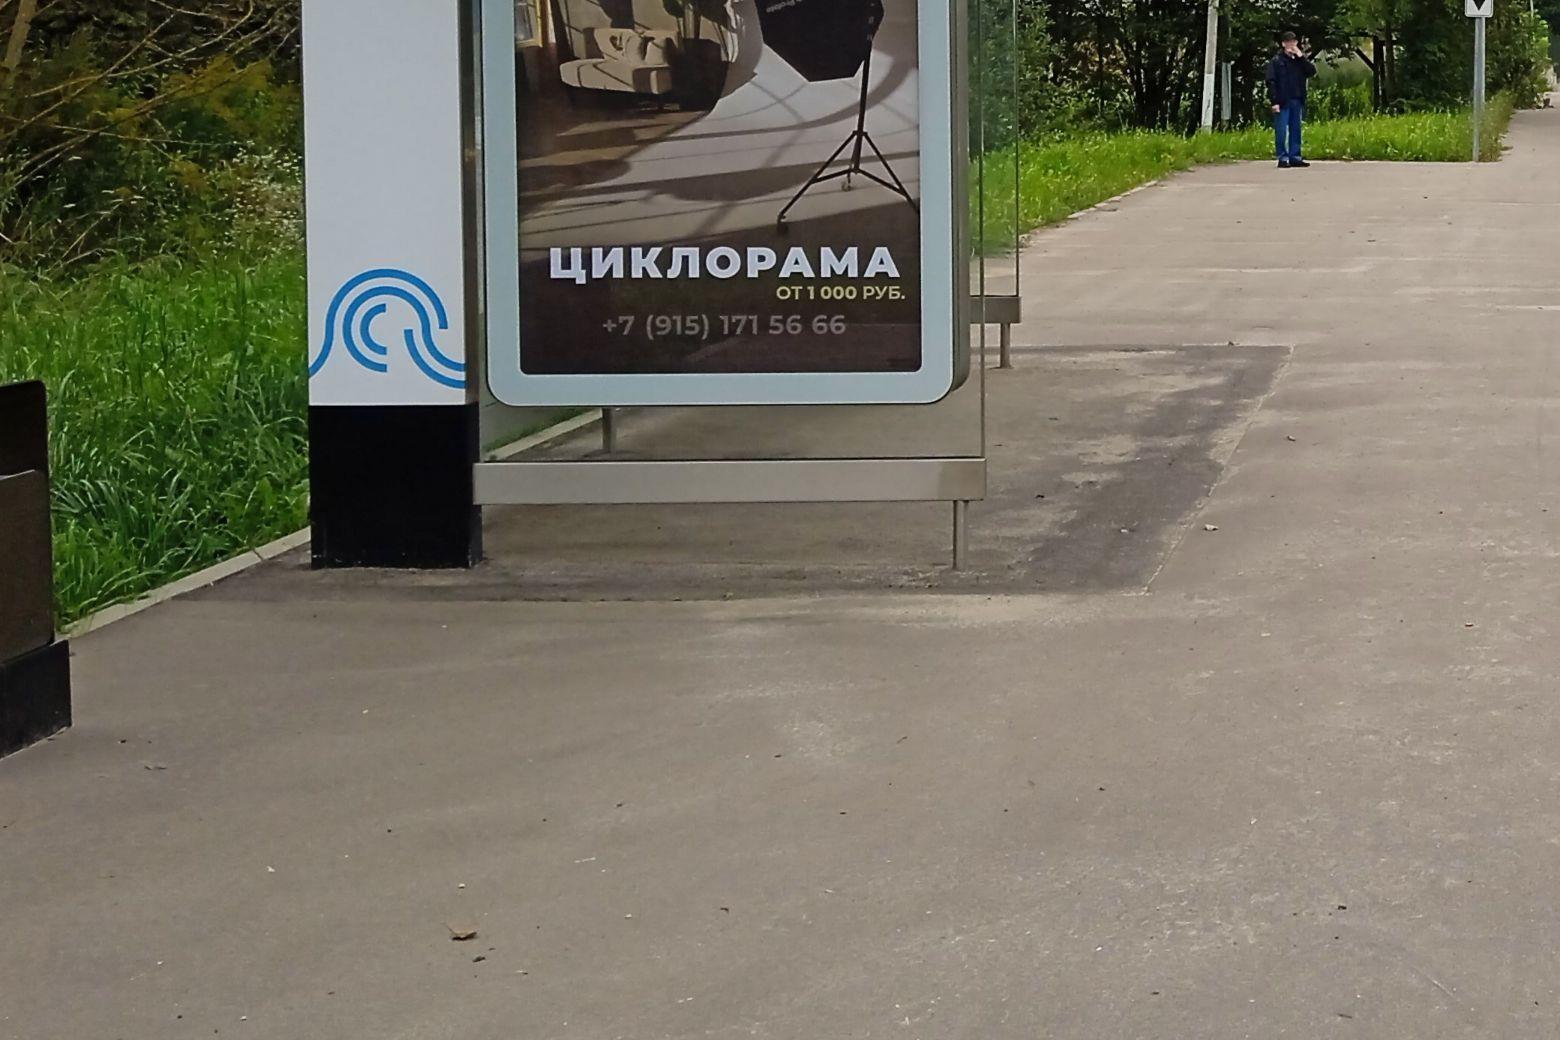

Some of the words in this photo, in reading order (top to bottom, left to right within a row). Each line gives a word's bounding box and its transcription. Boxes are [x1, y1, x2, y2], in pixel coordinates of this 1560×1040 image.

[550, 246, 900, 285] ЦИКЛОРАМА
[776, 286, 802, 300] ОТ
[862, 286, 906, 300] РУБ.
[602, 315, 635, 336] +7
[646, 314, 709, 340] (915)
[719, 315, 758, 335] 171
[768, 315, 802, 335] 56
[811, 315, 847, 335] 66
